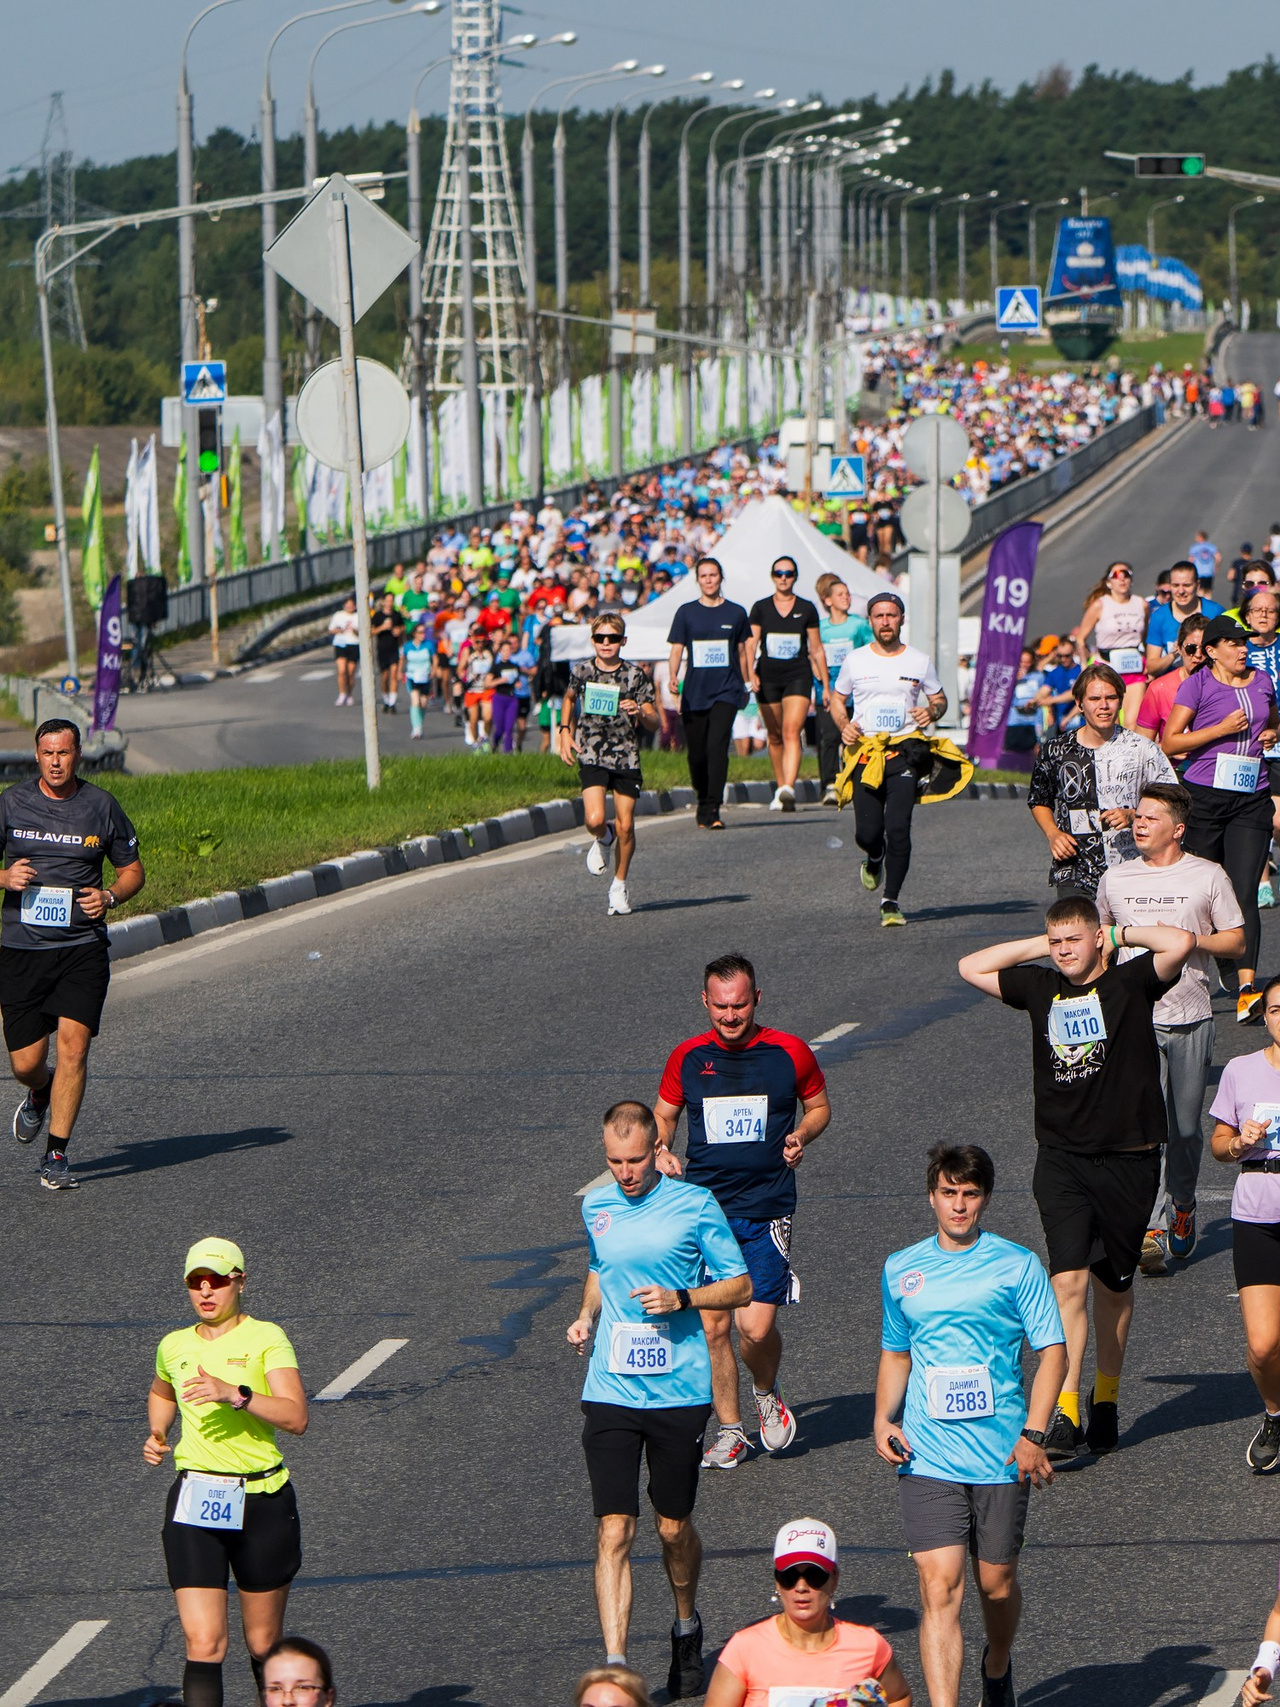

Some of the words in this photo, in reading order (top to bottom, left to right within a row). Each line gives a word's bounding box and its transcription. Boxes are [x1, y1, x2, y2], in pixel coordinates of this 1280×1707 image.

[993, 575, 1029, 608] 19
[704, 653, 725, 664] 2660
[589, 698, 614, 712] 3070
[876, 716, 901, 728] 3005
[1233, 773, 1256, 788] 1388
[13, 829, 82, 845] GISLAVED
[38, 897, 64, 905] НИКОЛАЙ
[35, 905, 66, 922] 2003
[1064, 1008, 1090, 1019] МАКСИМ
[1064, 1017, 1099, 1039] 1410
[725, 1118, 762, 1137] 3474
[631, 1337, 660, 1346] МАКСИМ
[626, 1347, 667, 1368] 4358
[949, 1379, 979, 1391] ДАНИИЛ
[945, 1390, 987, 1413] 2583
[208, 1489, 227, 1499] ОЛЕГ
[200, 1500, 232, 1522] 284
[816, 1538, 826, 1549] 18
